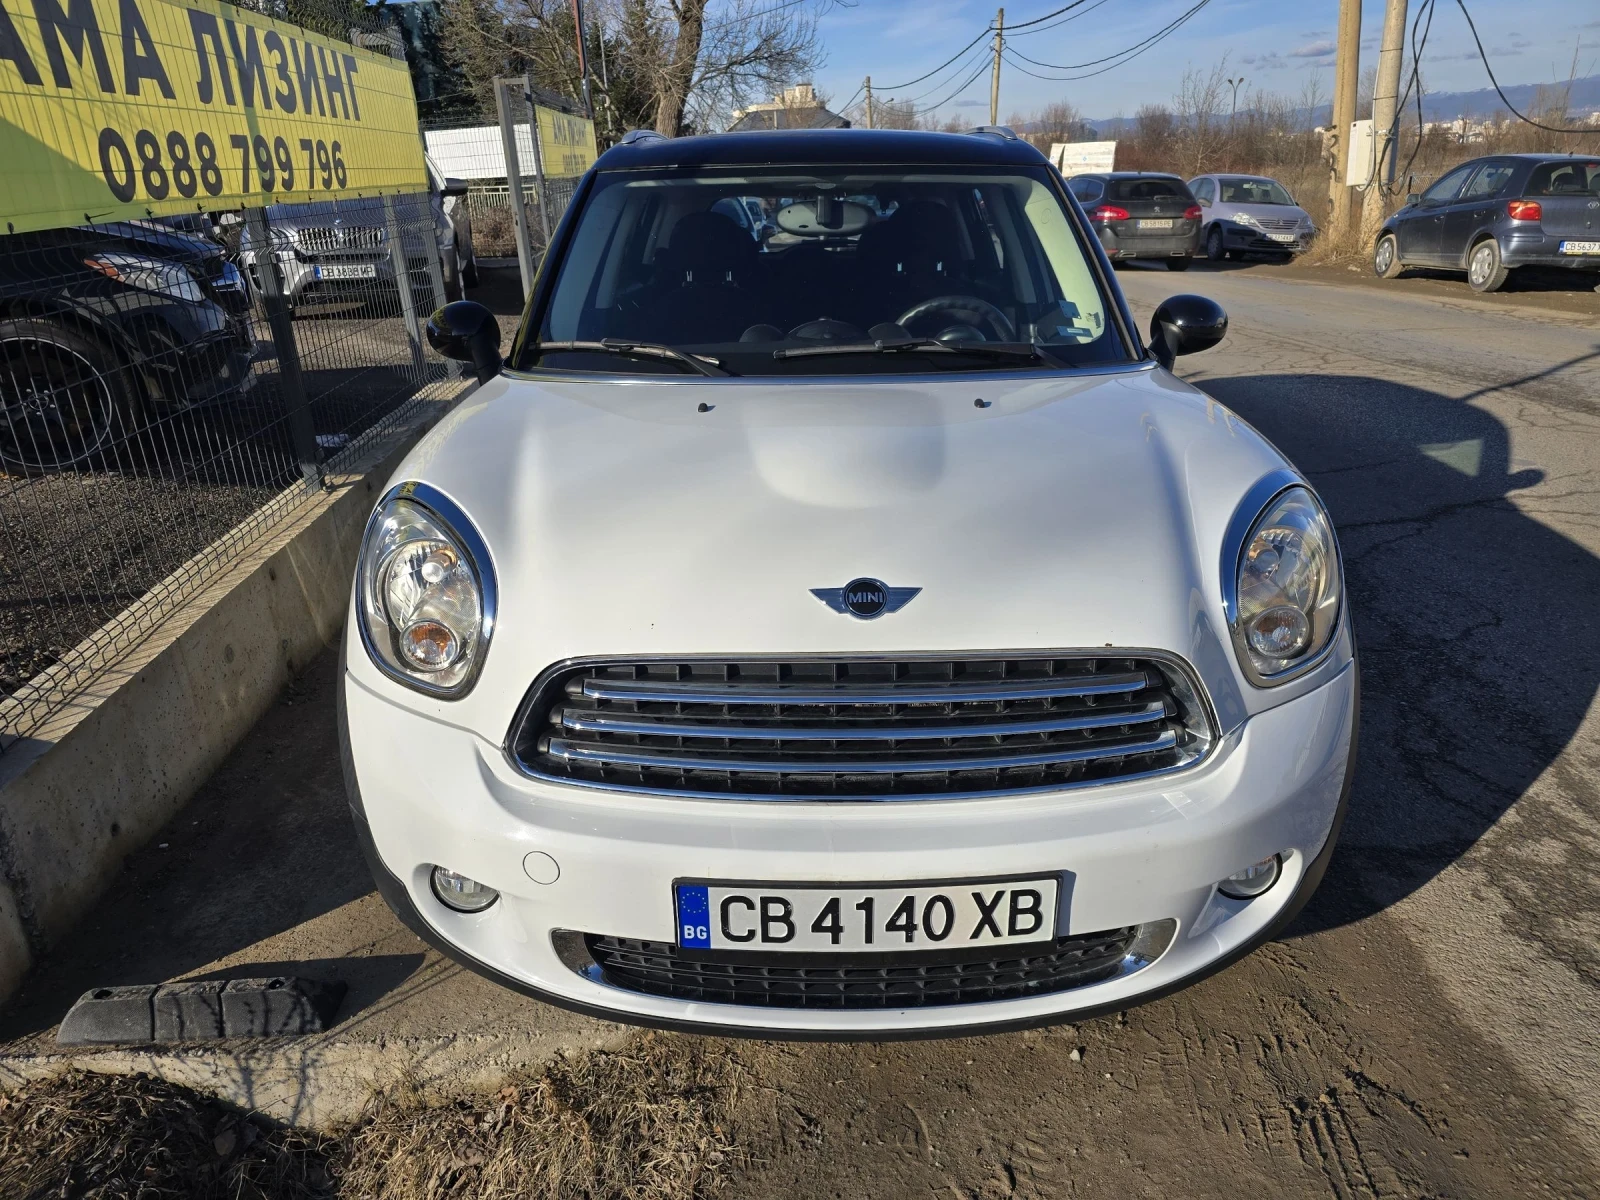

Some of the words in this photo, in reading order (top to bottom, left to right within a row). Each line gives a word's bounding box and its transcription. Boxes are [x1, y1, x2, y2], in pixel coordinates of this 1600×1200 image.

[186, 7, 361, 122] ЛИЗИНГ
[99, 127, 223, 202] 0888
[230, 134, 294, 192] 799
[301, 138, 347, 190] 796
[1565, 242, 1576, 251] CB
[1577, 242, 1597, 251] 5637
[848, 591, 884, 603] MINI
[684, 925, 708, 939] BG
[720, 895, 796, 944] CB
[810, 894, 956, 945] 4140
[969, 889, 1044, 940] XB
